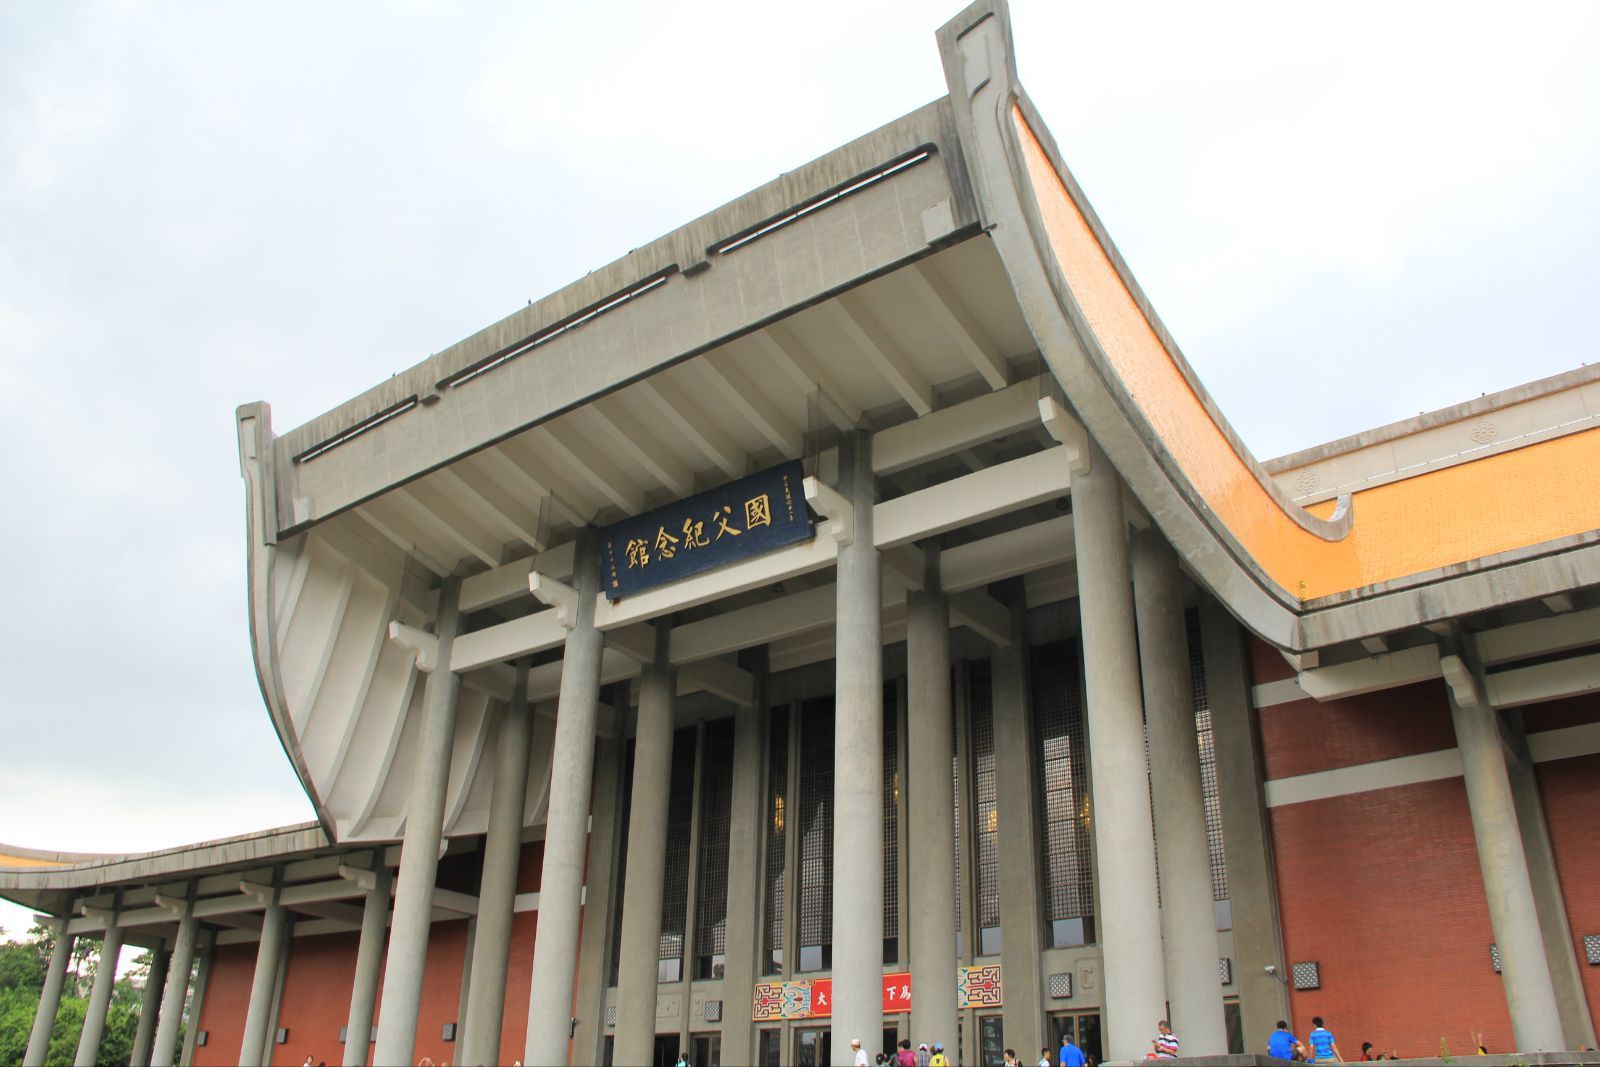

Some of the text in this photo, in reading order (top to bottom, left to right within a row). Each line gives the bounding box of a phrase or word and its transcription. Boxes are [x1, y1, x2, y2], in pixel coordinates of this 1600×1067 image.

[625, 493, 772, 569] 國父紀念館
